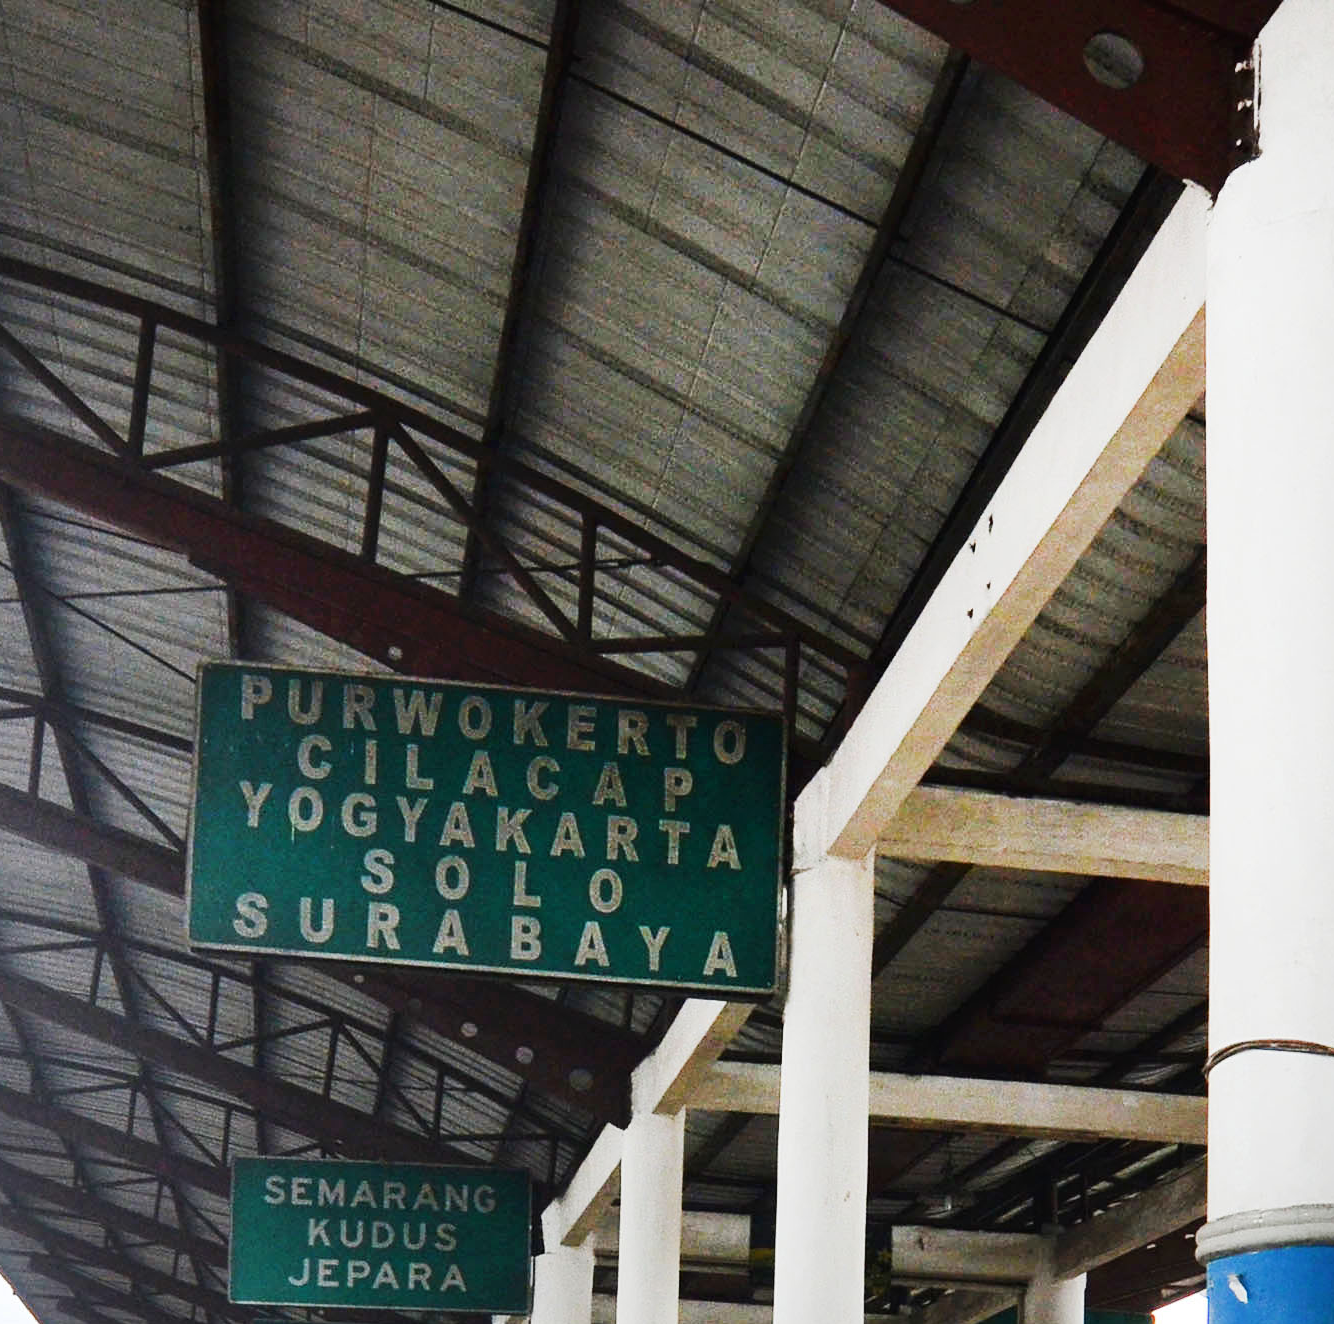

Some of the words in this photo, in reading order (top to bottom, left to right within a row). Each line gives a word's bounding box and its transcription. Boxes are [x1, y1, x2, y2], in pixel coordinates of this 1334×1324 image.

[241, 674, 747, 764] PURWOKERTO
[297, 735, 693, 811] CILACAP
[238, 780, 741, 870] YOGYAKARTA
[360, 849, 623, 913] SOLO
[233, 892, 739, 978] SURABAYA
[264, 1174, 497, 1214] SEMARANG
[308, 1217, 457, 1251] KUDUS
[288, 1258, 467, 1292] JEPARA
